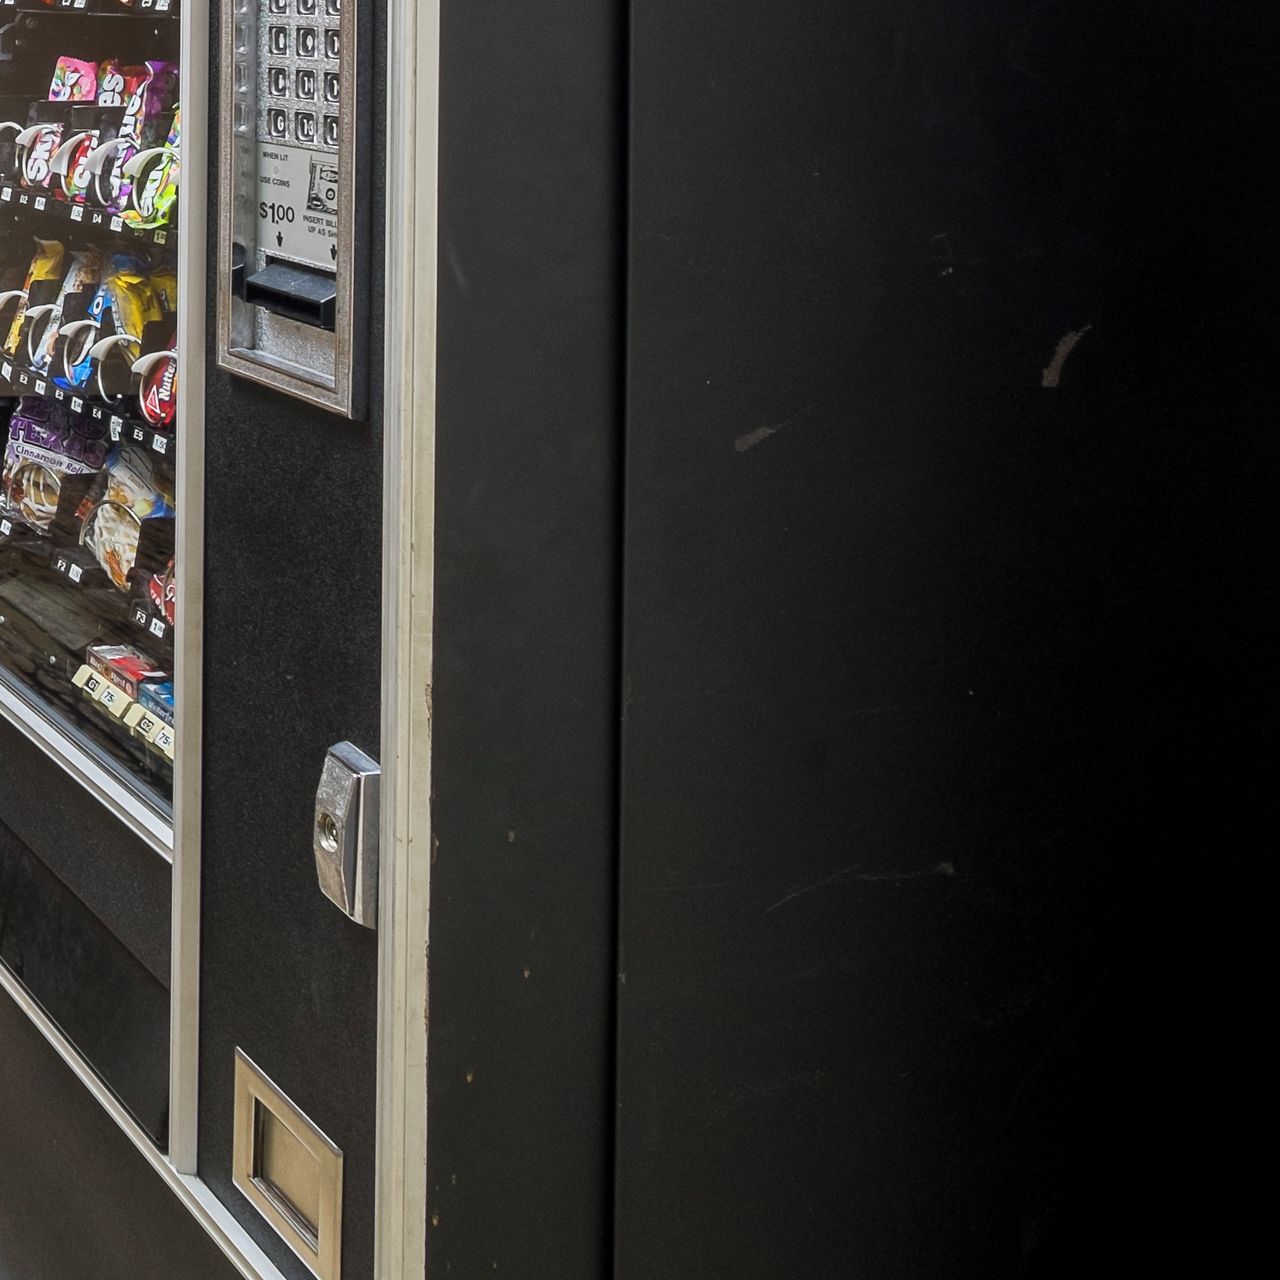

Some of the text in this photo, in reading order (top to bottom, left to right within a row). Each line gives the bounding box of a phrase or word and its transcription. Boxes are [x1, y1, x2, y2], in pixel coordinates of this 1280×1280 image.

[277, 115, 285, 132] G
[303, 118, 314, 136] 13
[262, 151, 279, 160] WHEN
[272, 178, 290, 188] COINS
[260, 201, 295, 224] $1.00
[92, 213, 101, 223] D4
[303, 215, 324, 224] INSERT
[318, 228, 327, 236] AS
[20, 374, 28, 384] E2
[55, 390, 64, 400] E3
[92, 408, 102, 419] E4
[133, 429, 143, 440] E5
[15, 445, 64, 467] Cinnamon
[57, 560, 66, 571] F2
[136, 611, 146, 623] F3
